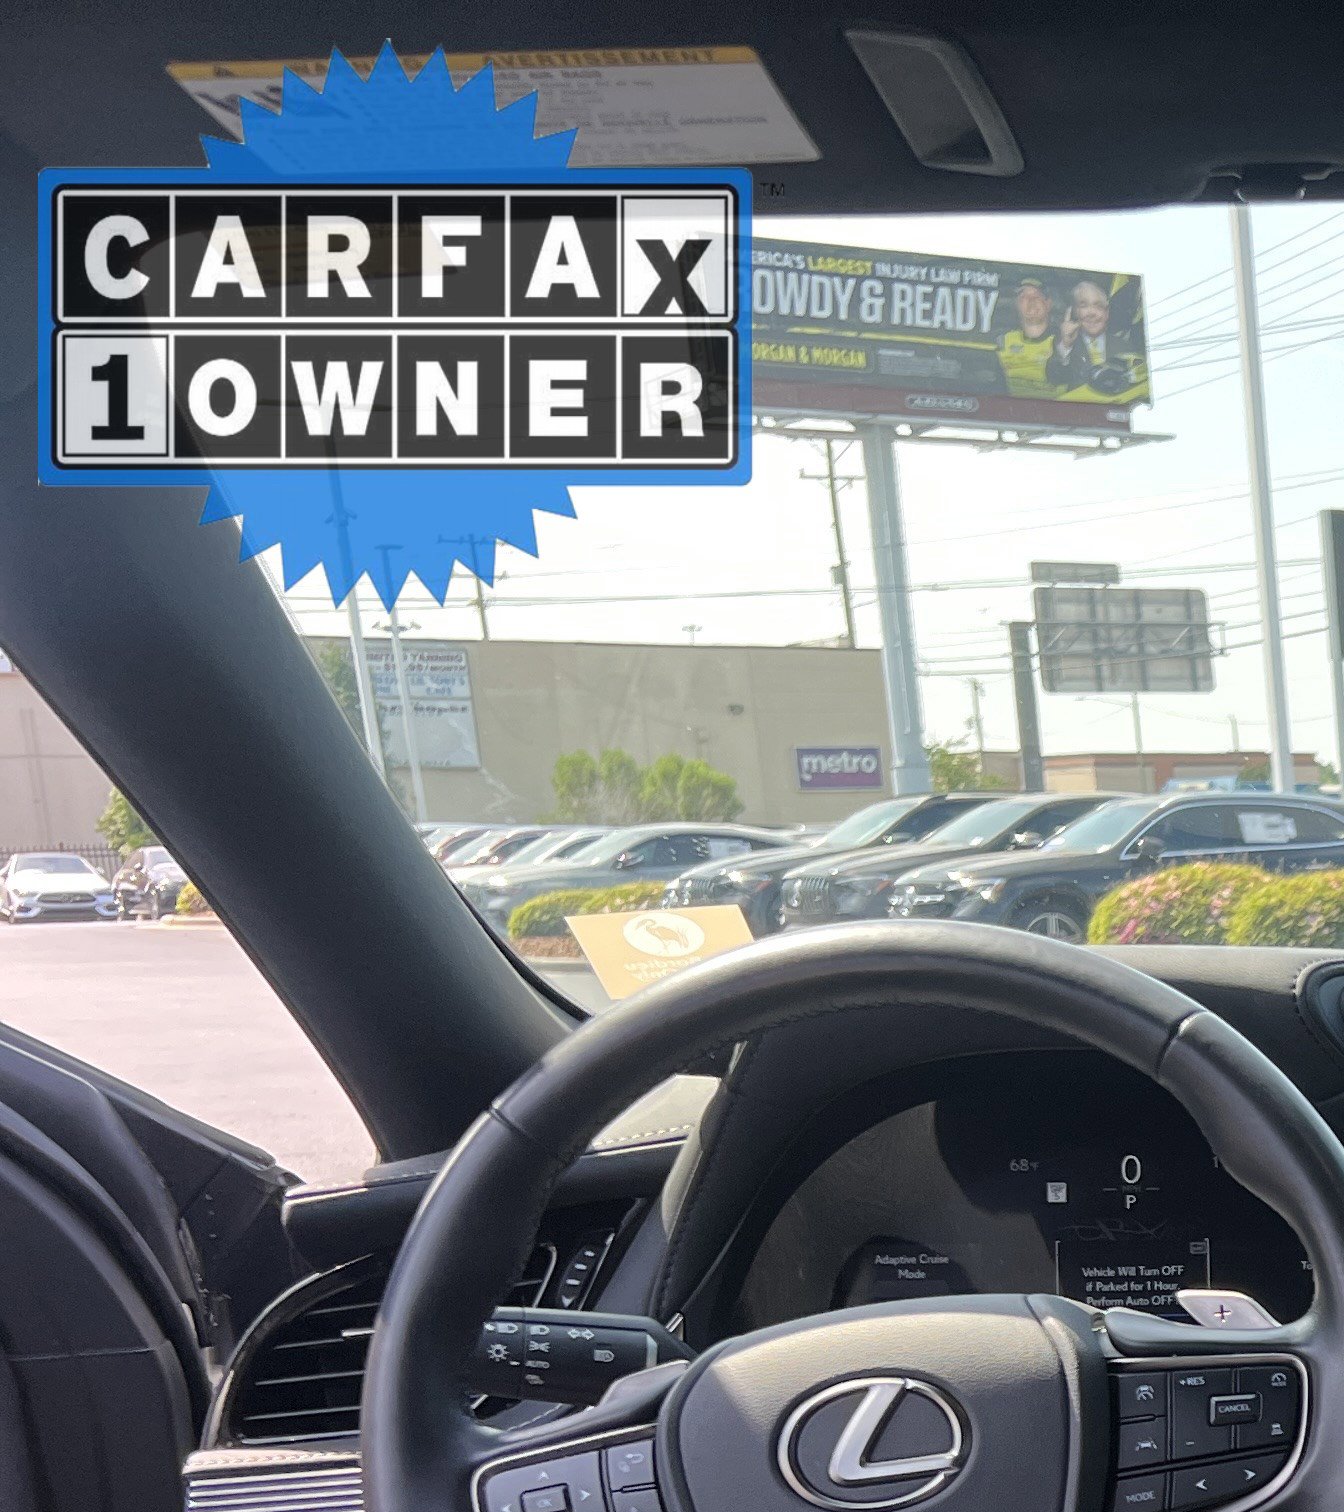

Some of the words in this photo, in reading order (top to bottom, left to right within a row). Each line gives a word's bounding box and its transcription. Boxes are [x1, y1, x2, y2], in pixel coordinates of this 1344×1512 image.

[752, 249, 805, 269] ERICA'S
[806, 255, 873, 276] LARGEST
[753, 268, 857, 321] OWDY
[859, 278, 886, 324] &
[891, 282, 999, 333] READY
[752, 341, 797, 362] ORGAN
[801, 751, 878, 775] metro
[1121, 1154, 1141, 1184] 0
[1126, 1194, 1137, 1210] P
[1082, 1267, 1116, 1277] Vehicle
[1118, 1266, 1137, 1276] Will
[1139, 1266, 1160, 1276] Turn
[1161, 1265, 1185, 1276] OFF
[1096, 1282, 1128, 1292] Parked
[1130, 1282, 1143, 1291] for
[1152, 1296, 1179, 1306] OFF
[1218, 1403, 1250, 1414] CANCEL
[1126, 1490, 1156, 1503] MODE
